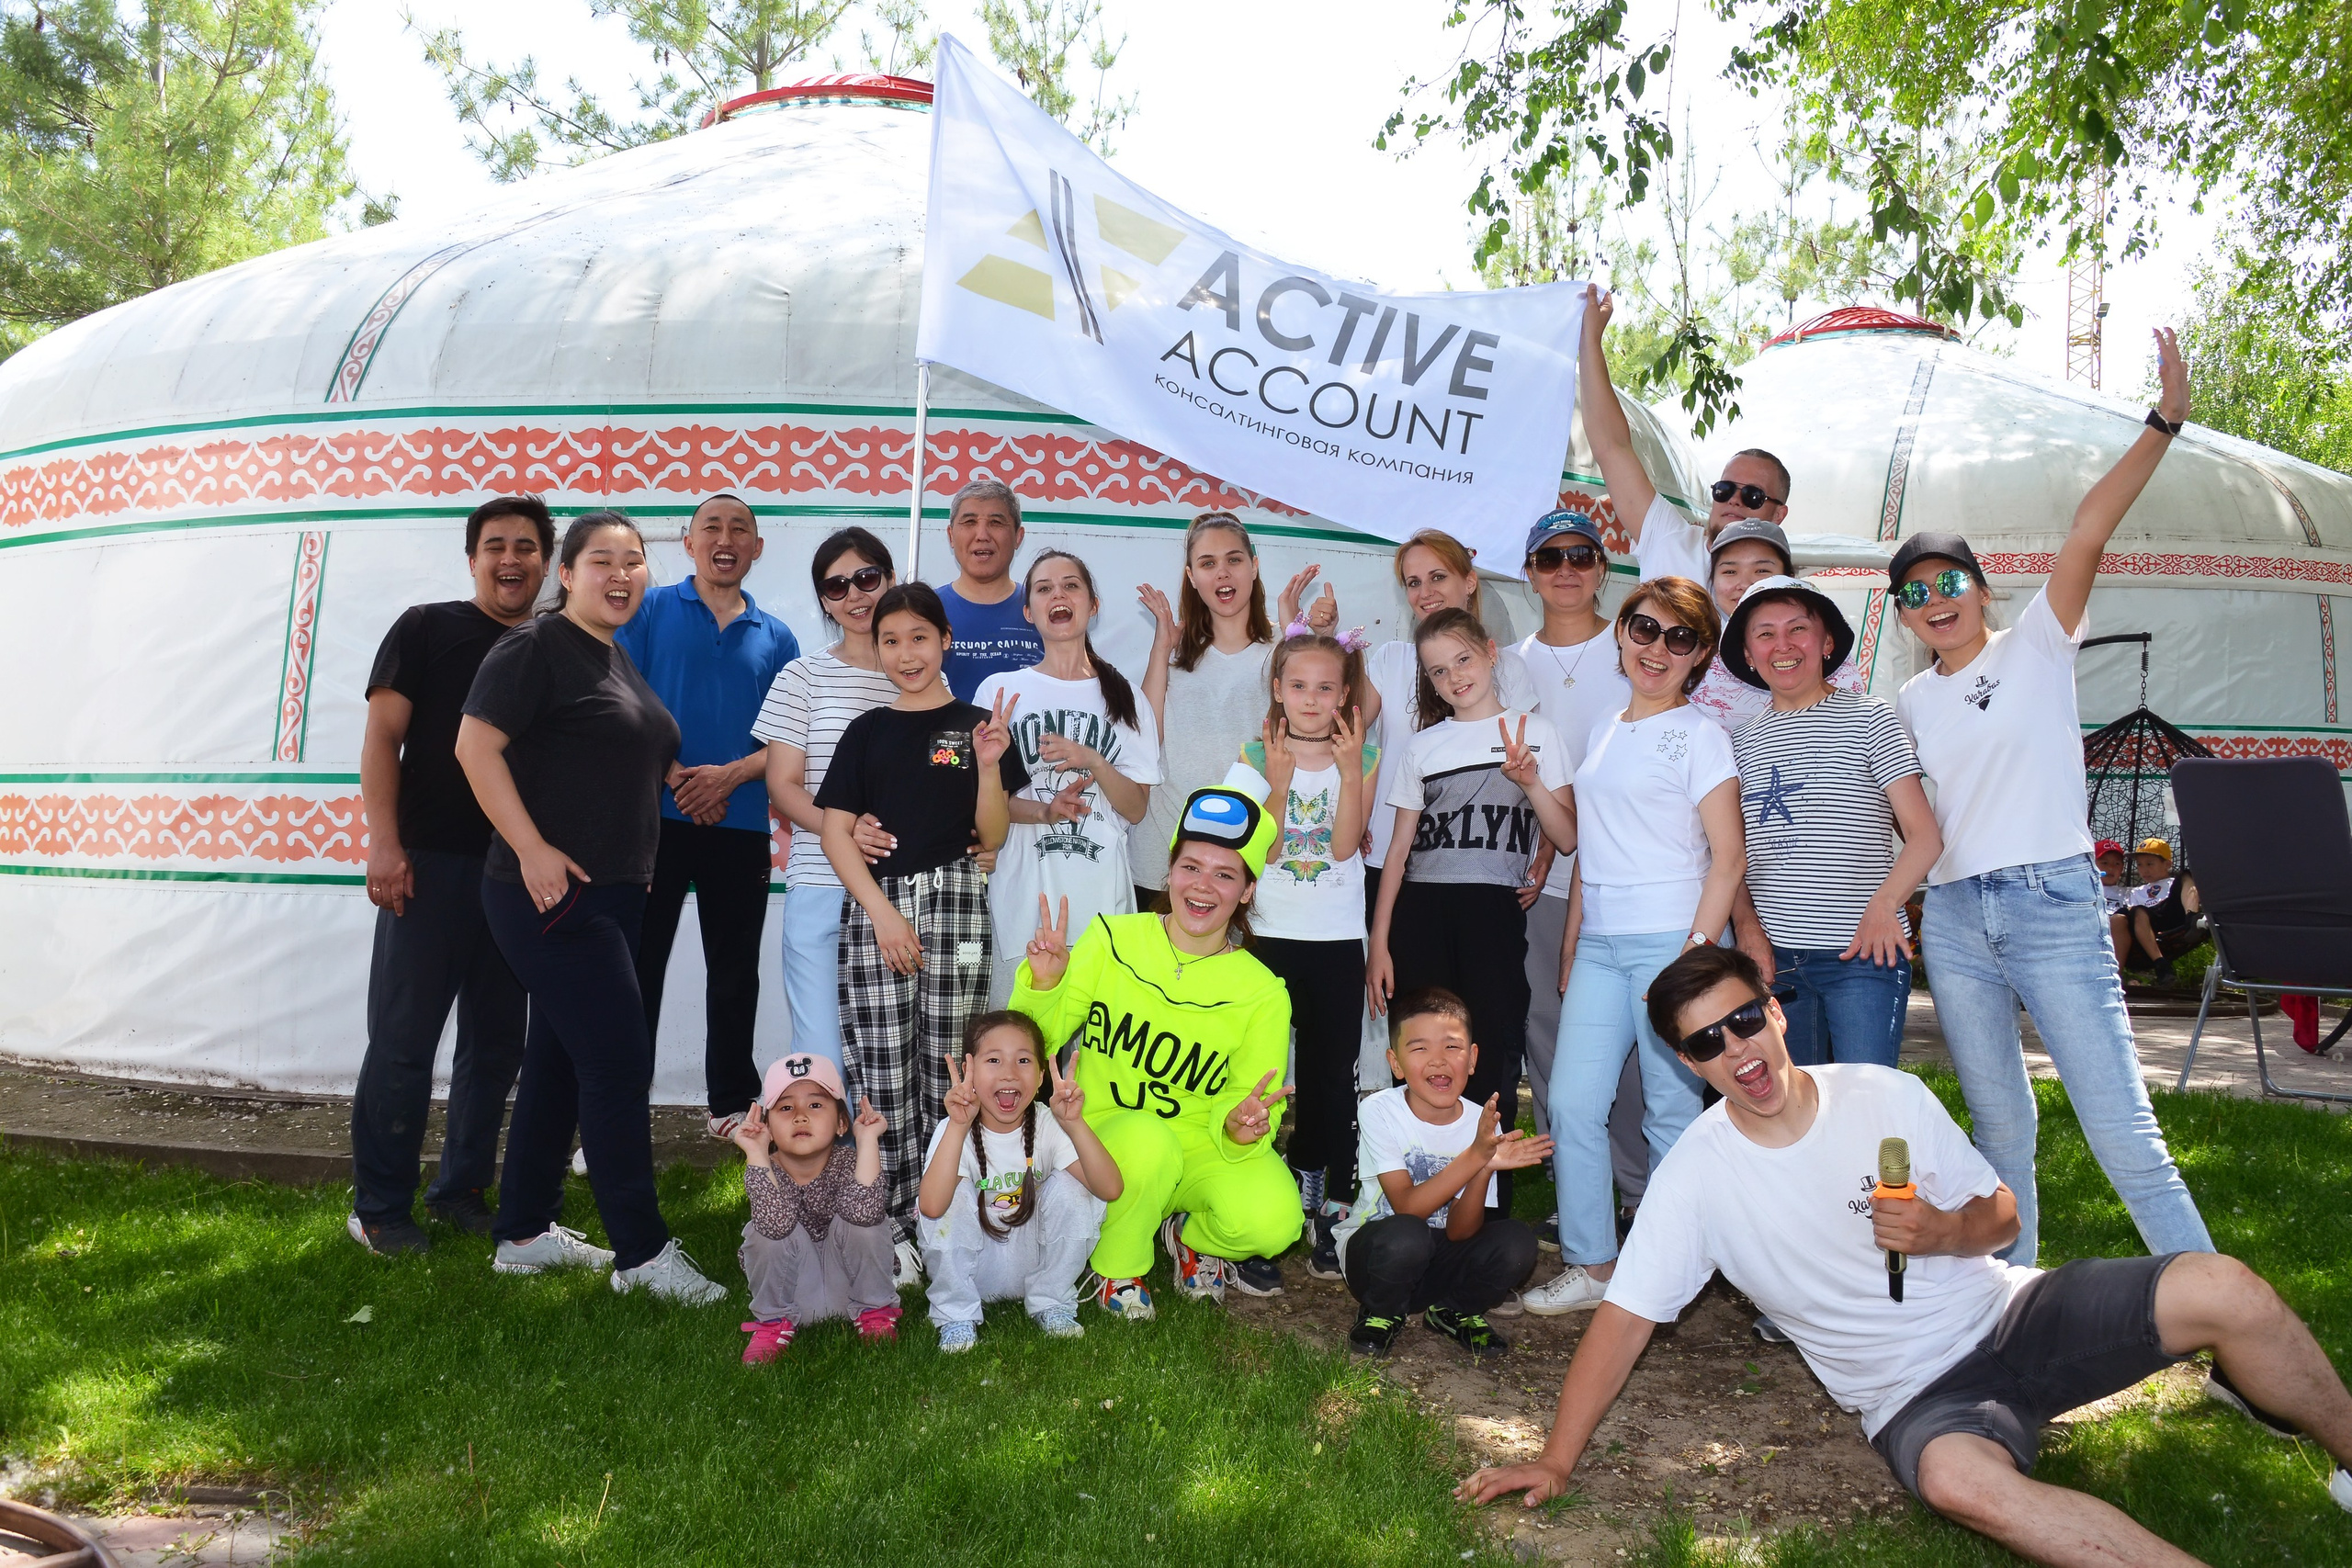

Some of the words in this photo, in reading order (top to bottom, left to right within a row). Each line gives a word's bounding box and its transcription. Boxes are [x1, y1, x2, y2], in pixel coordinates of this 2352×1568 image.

[1176, 250, 1500, 400] ACTIVE
[1160, 331, 1484, 455] ACCOUNT
[1964, 679, 2001, 705] Karabas
[1082, 1000, 1229, 1096] AMONG
[1109, 1081, 1181, 1119] US
